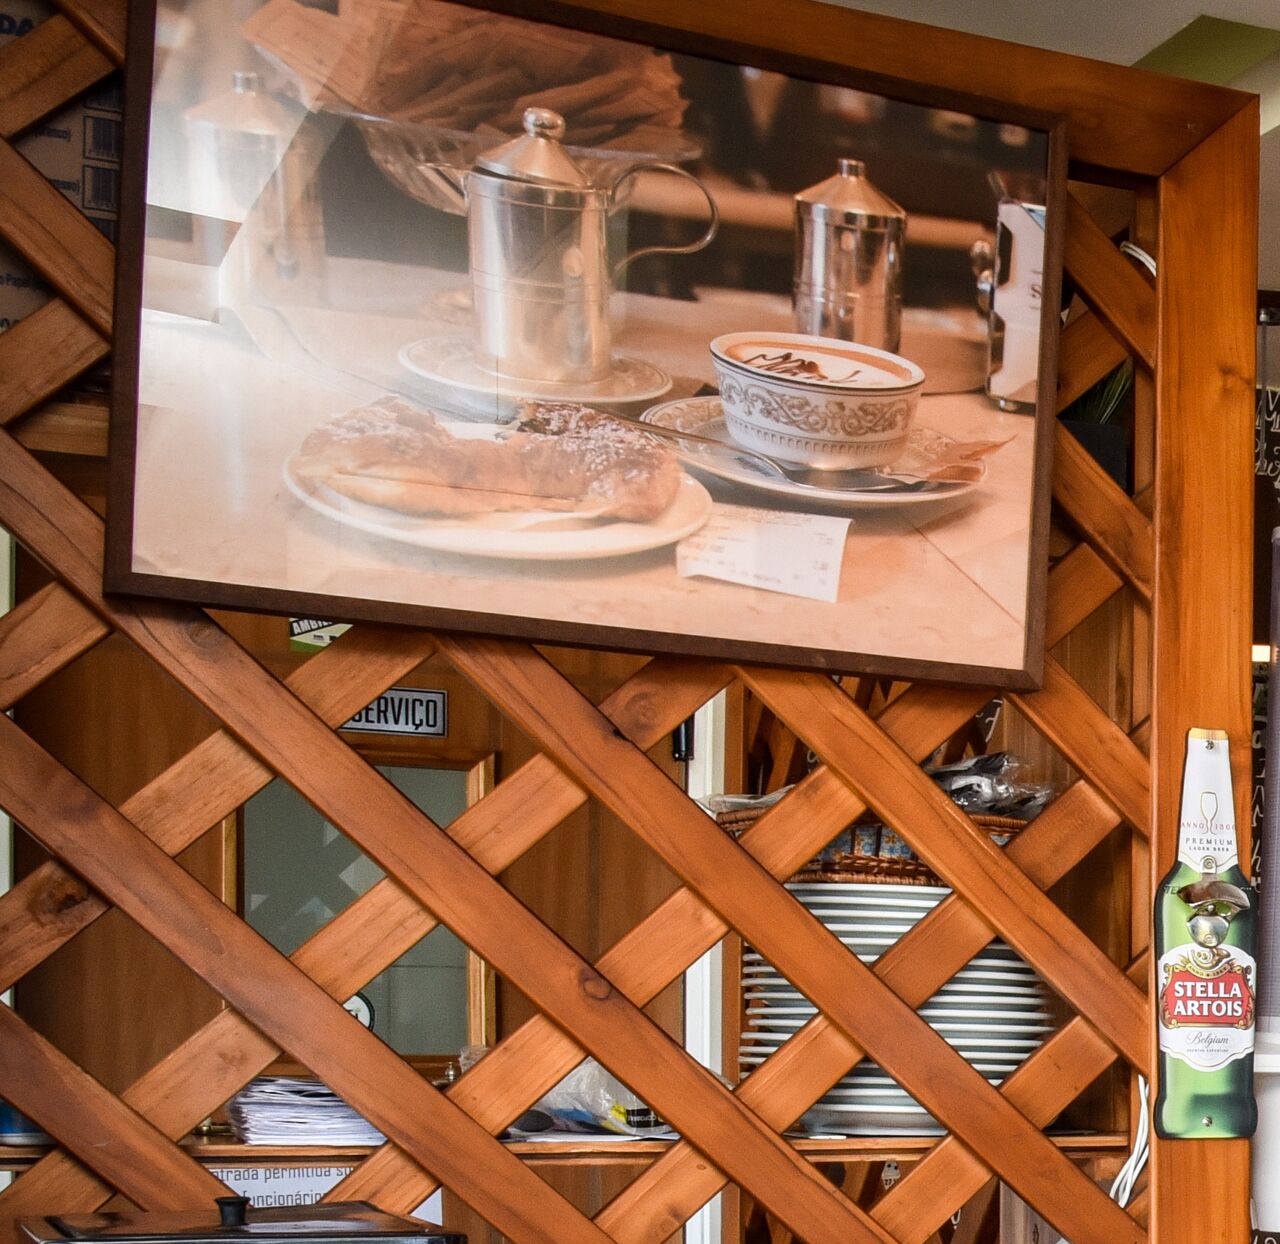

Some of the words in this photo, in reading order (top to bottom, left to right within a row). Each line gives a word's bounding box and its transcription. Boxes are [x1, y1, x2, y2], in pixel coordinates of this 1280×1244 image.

[1174, 982, 1242, 998] STELLA
[1174, 1000, 1242, 1016] ARTOIS
[1186, 1032, 1228, 1047] Belgium
